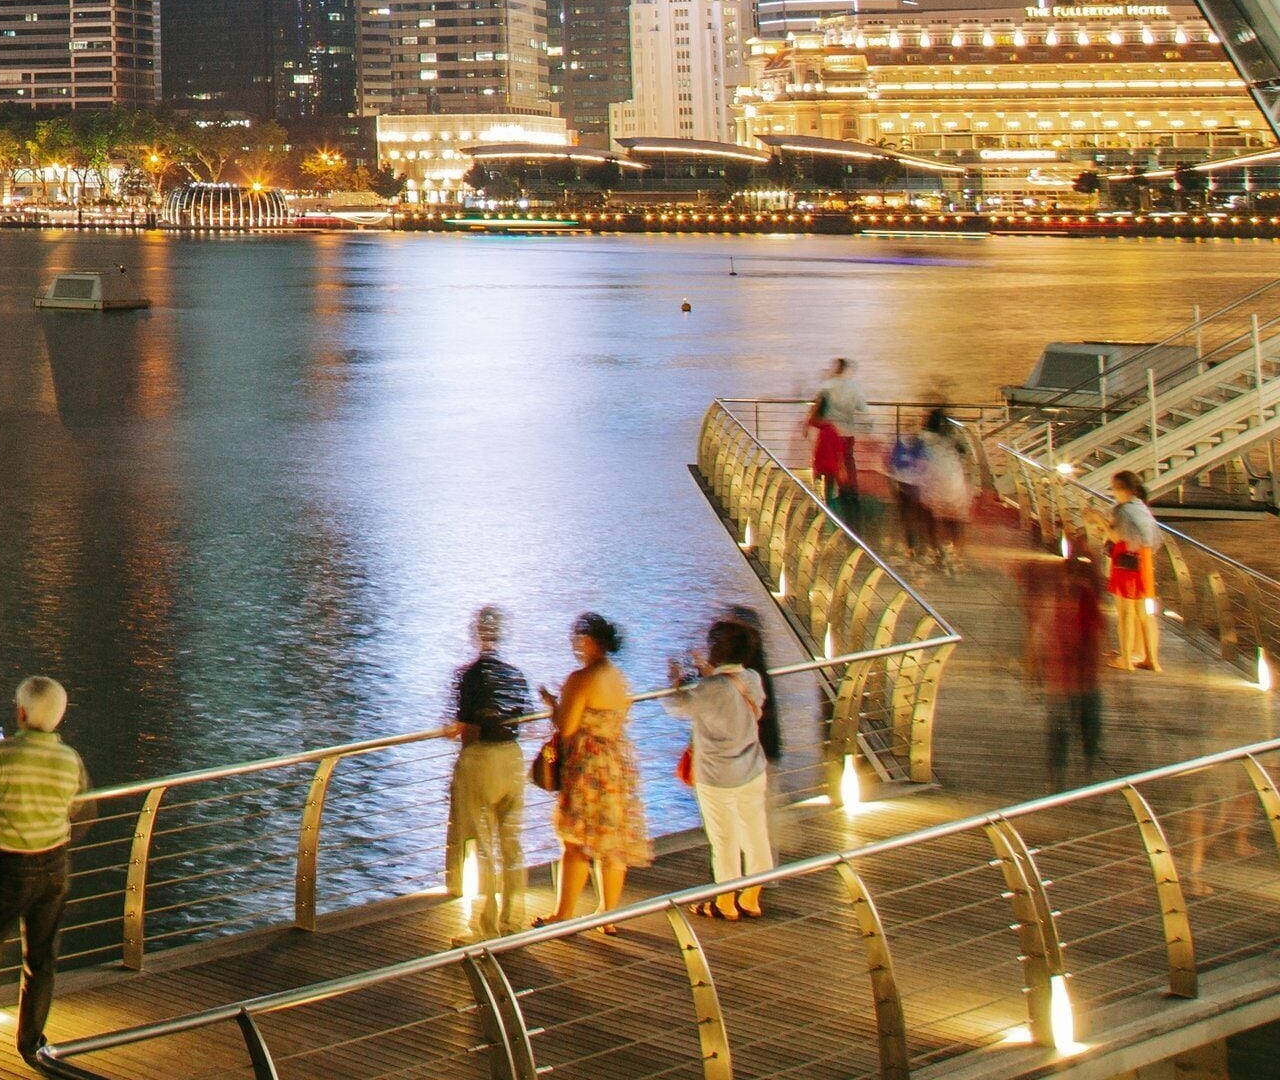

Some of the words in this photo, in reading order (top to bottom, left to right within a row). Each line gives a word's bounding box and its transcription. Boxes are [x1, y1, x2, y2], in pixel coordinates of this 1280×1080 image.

[1025, 6, 1050, 17] THE
[1053, 6, 1123, 17] FULLERTON
[1127, 5, 1170, 16] HOTEL
